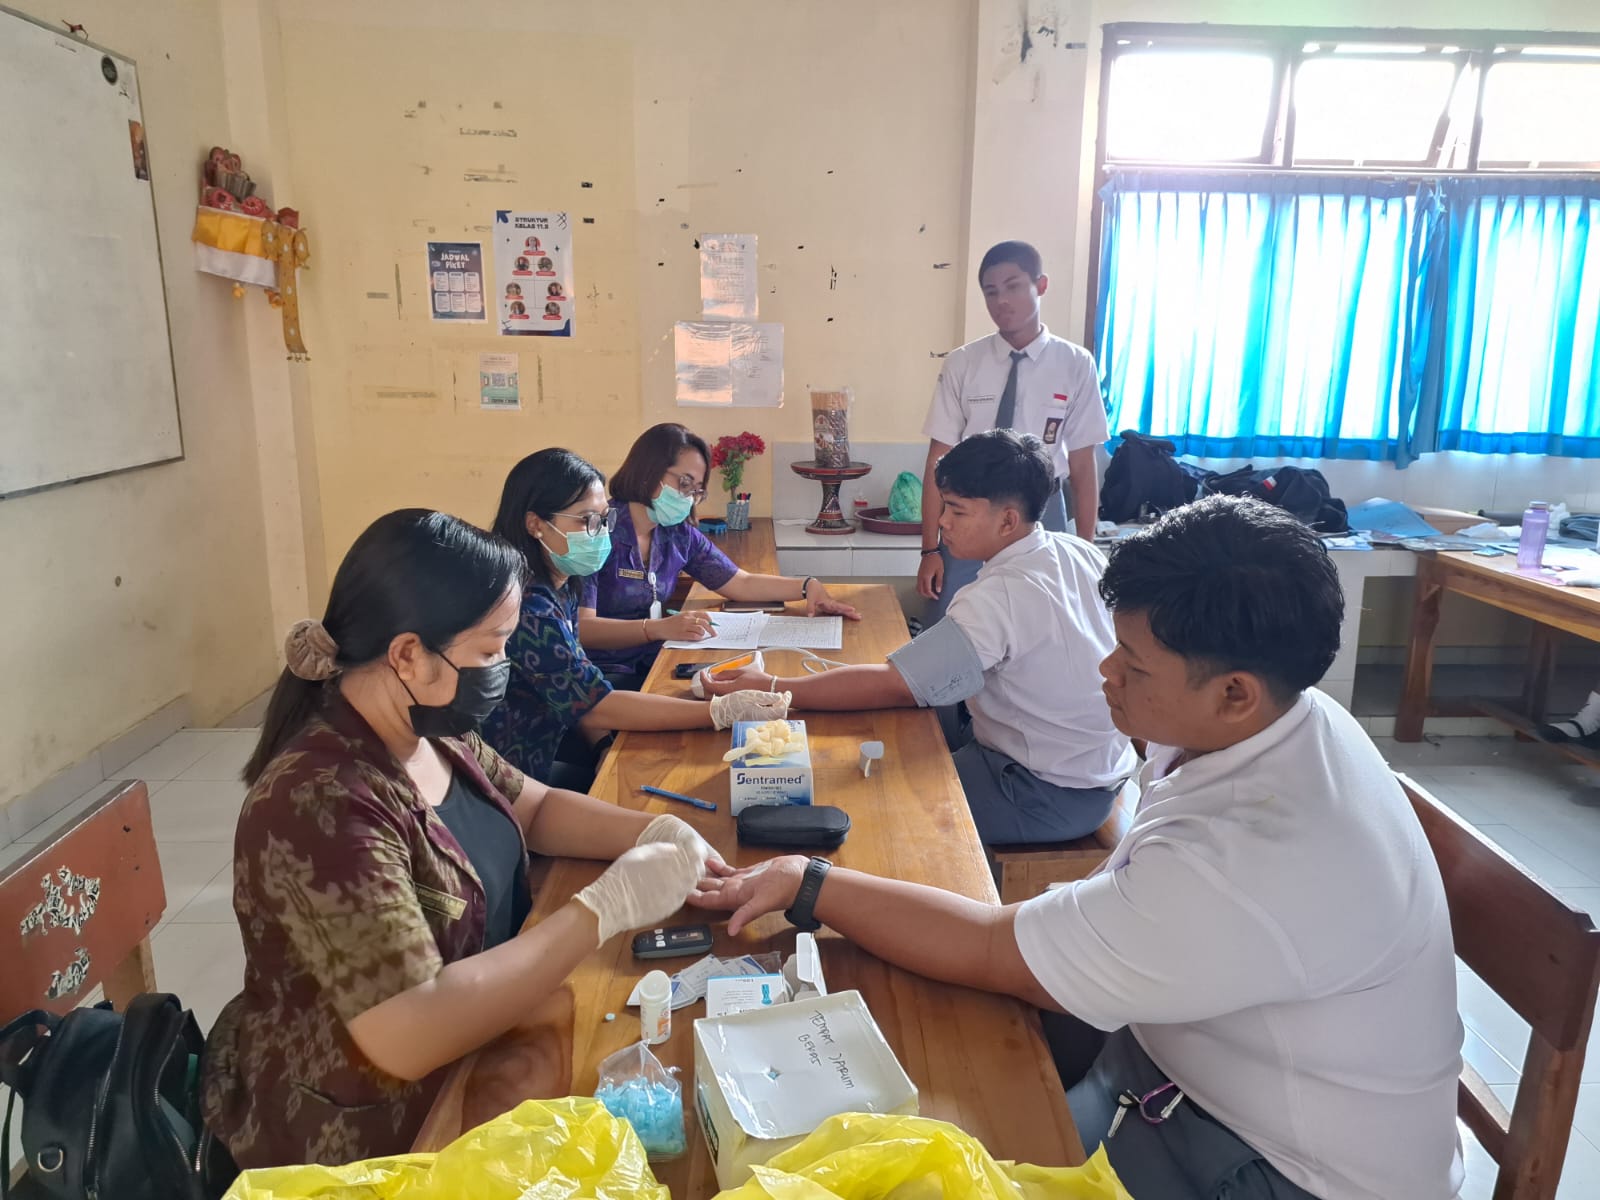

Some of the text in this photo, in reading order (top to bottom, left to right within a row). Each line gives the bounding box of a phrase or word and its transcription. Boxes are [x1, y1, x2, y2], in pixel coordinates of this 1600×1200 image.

[440, 253, 470, 262] JADWAL
[445, 261, 466, 269] PIKET
[736, 773, 802, 785] Sentramed
